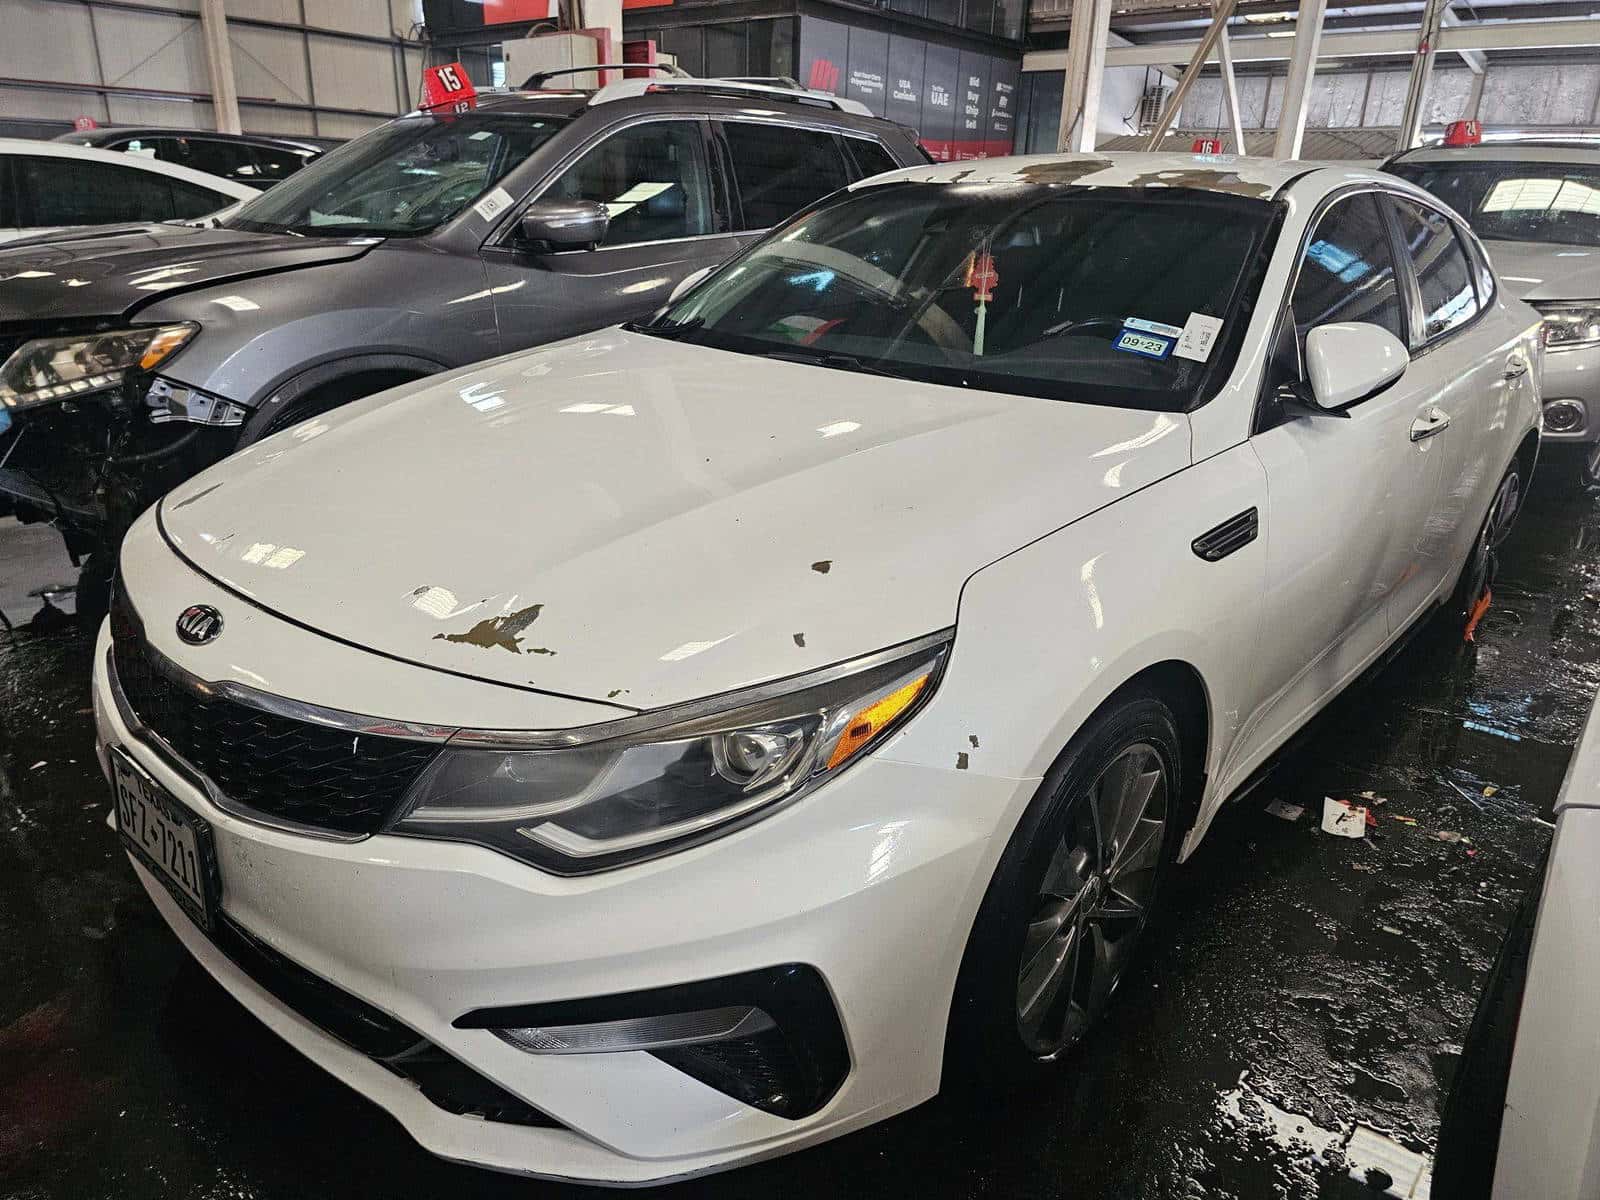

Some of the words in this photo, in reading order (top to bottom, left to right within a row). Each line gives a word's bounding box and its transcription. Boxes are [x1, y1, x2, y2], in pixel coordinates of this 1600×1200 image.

[437, 66, 461, 92] 15
[931, 91, 950, 106] UAE
[1465, 121, 1477, 136] 24
[1202, 140, 1213, 154] 16
[178, 611, 215, 640] KIA
